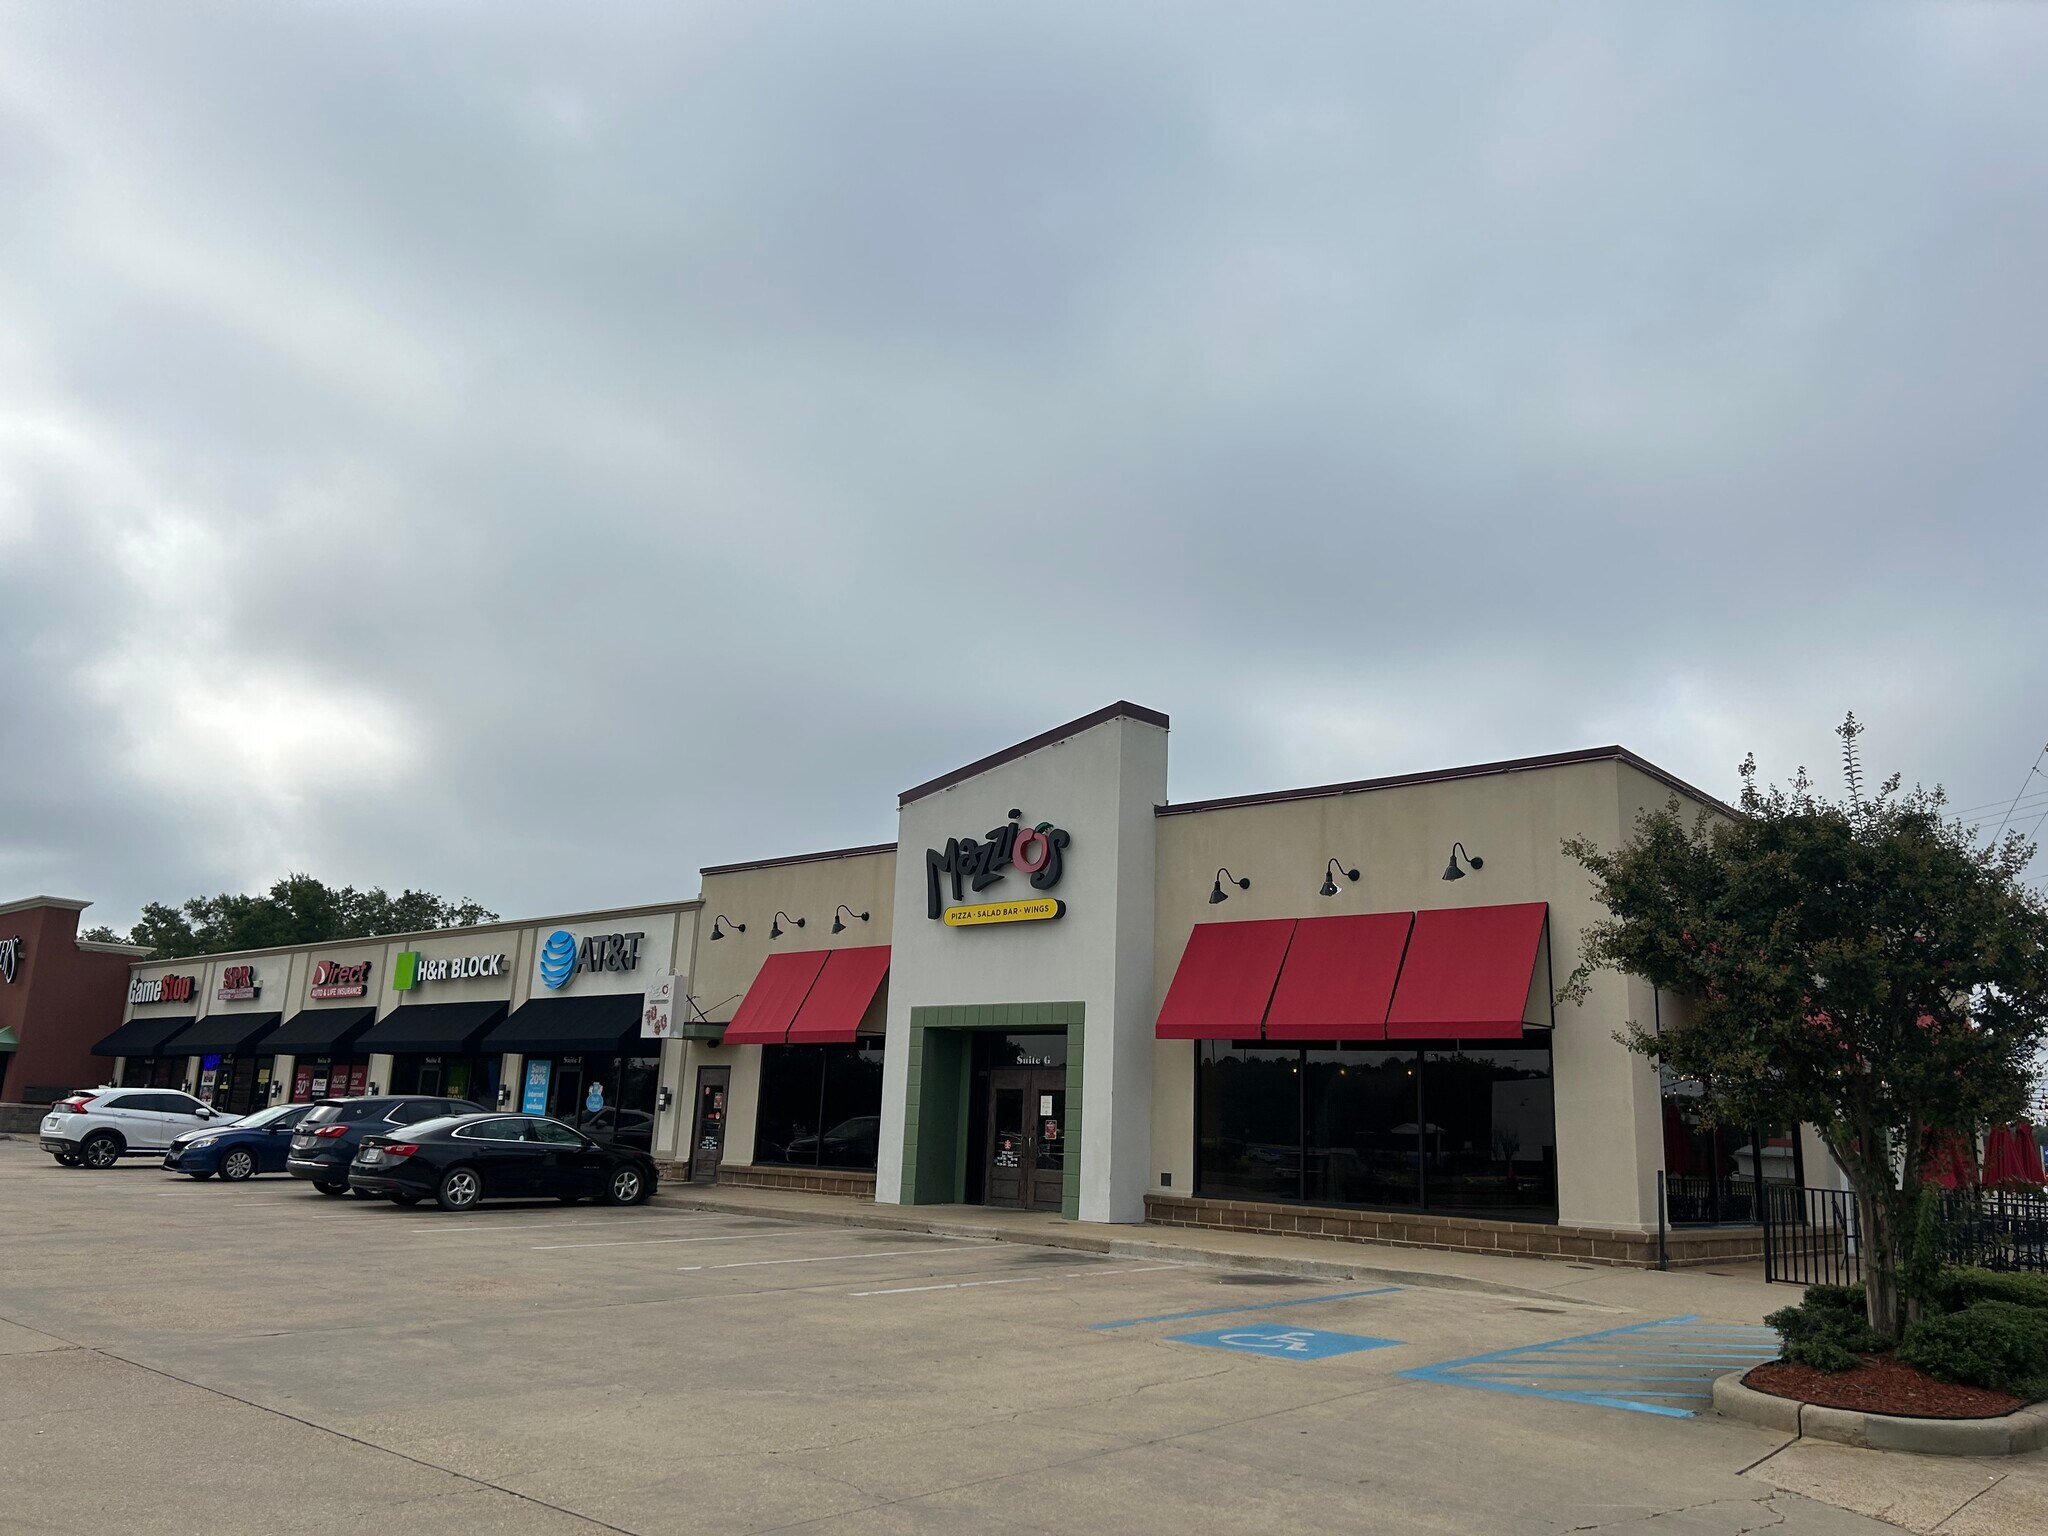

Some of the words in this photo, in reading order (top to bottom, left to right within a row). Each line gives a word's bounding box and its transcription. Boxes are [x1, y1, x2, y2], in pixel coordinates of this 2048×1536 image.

[950, 912, 972, 920] PIZZA
[977, 908, 1001, 918] SALAD
[1003, 907, 1018, 916] BAR
[1023, 904, 1049, 914] WINGS
[576, 931, 645, 974] AT&T
[223, 965, 252, 989] SPR
[312, 960, 368, 985] Direct
[417, 959, 446, 981] H&R
[451, 954, 501, 979] BLOCK
[128, 973, 193, 1003] GameStop
[312, 988, 324, 997] AUTO
[327, 987, 337, 996] LIFE
[338, 986, 362, 996] INSURANCE
[531, 1063, 547, 1074] Save
[1016, 1055, 1041, 1065] Suite
[1044, 1055, 1051, 1065] G
[529, 1074, 546, 1085] 20%
